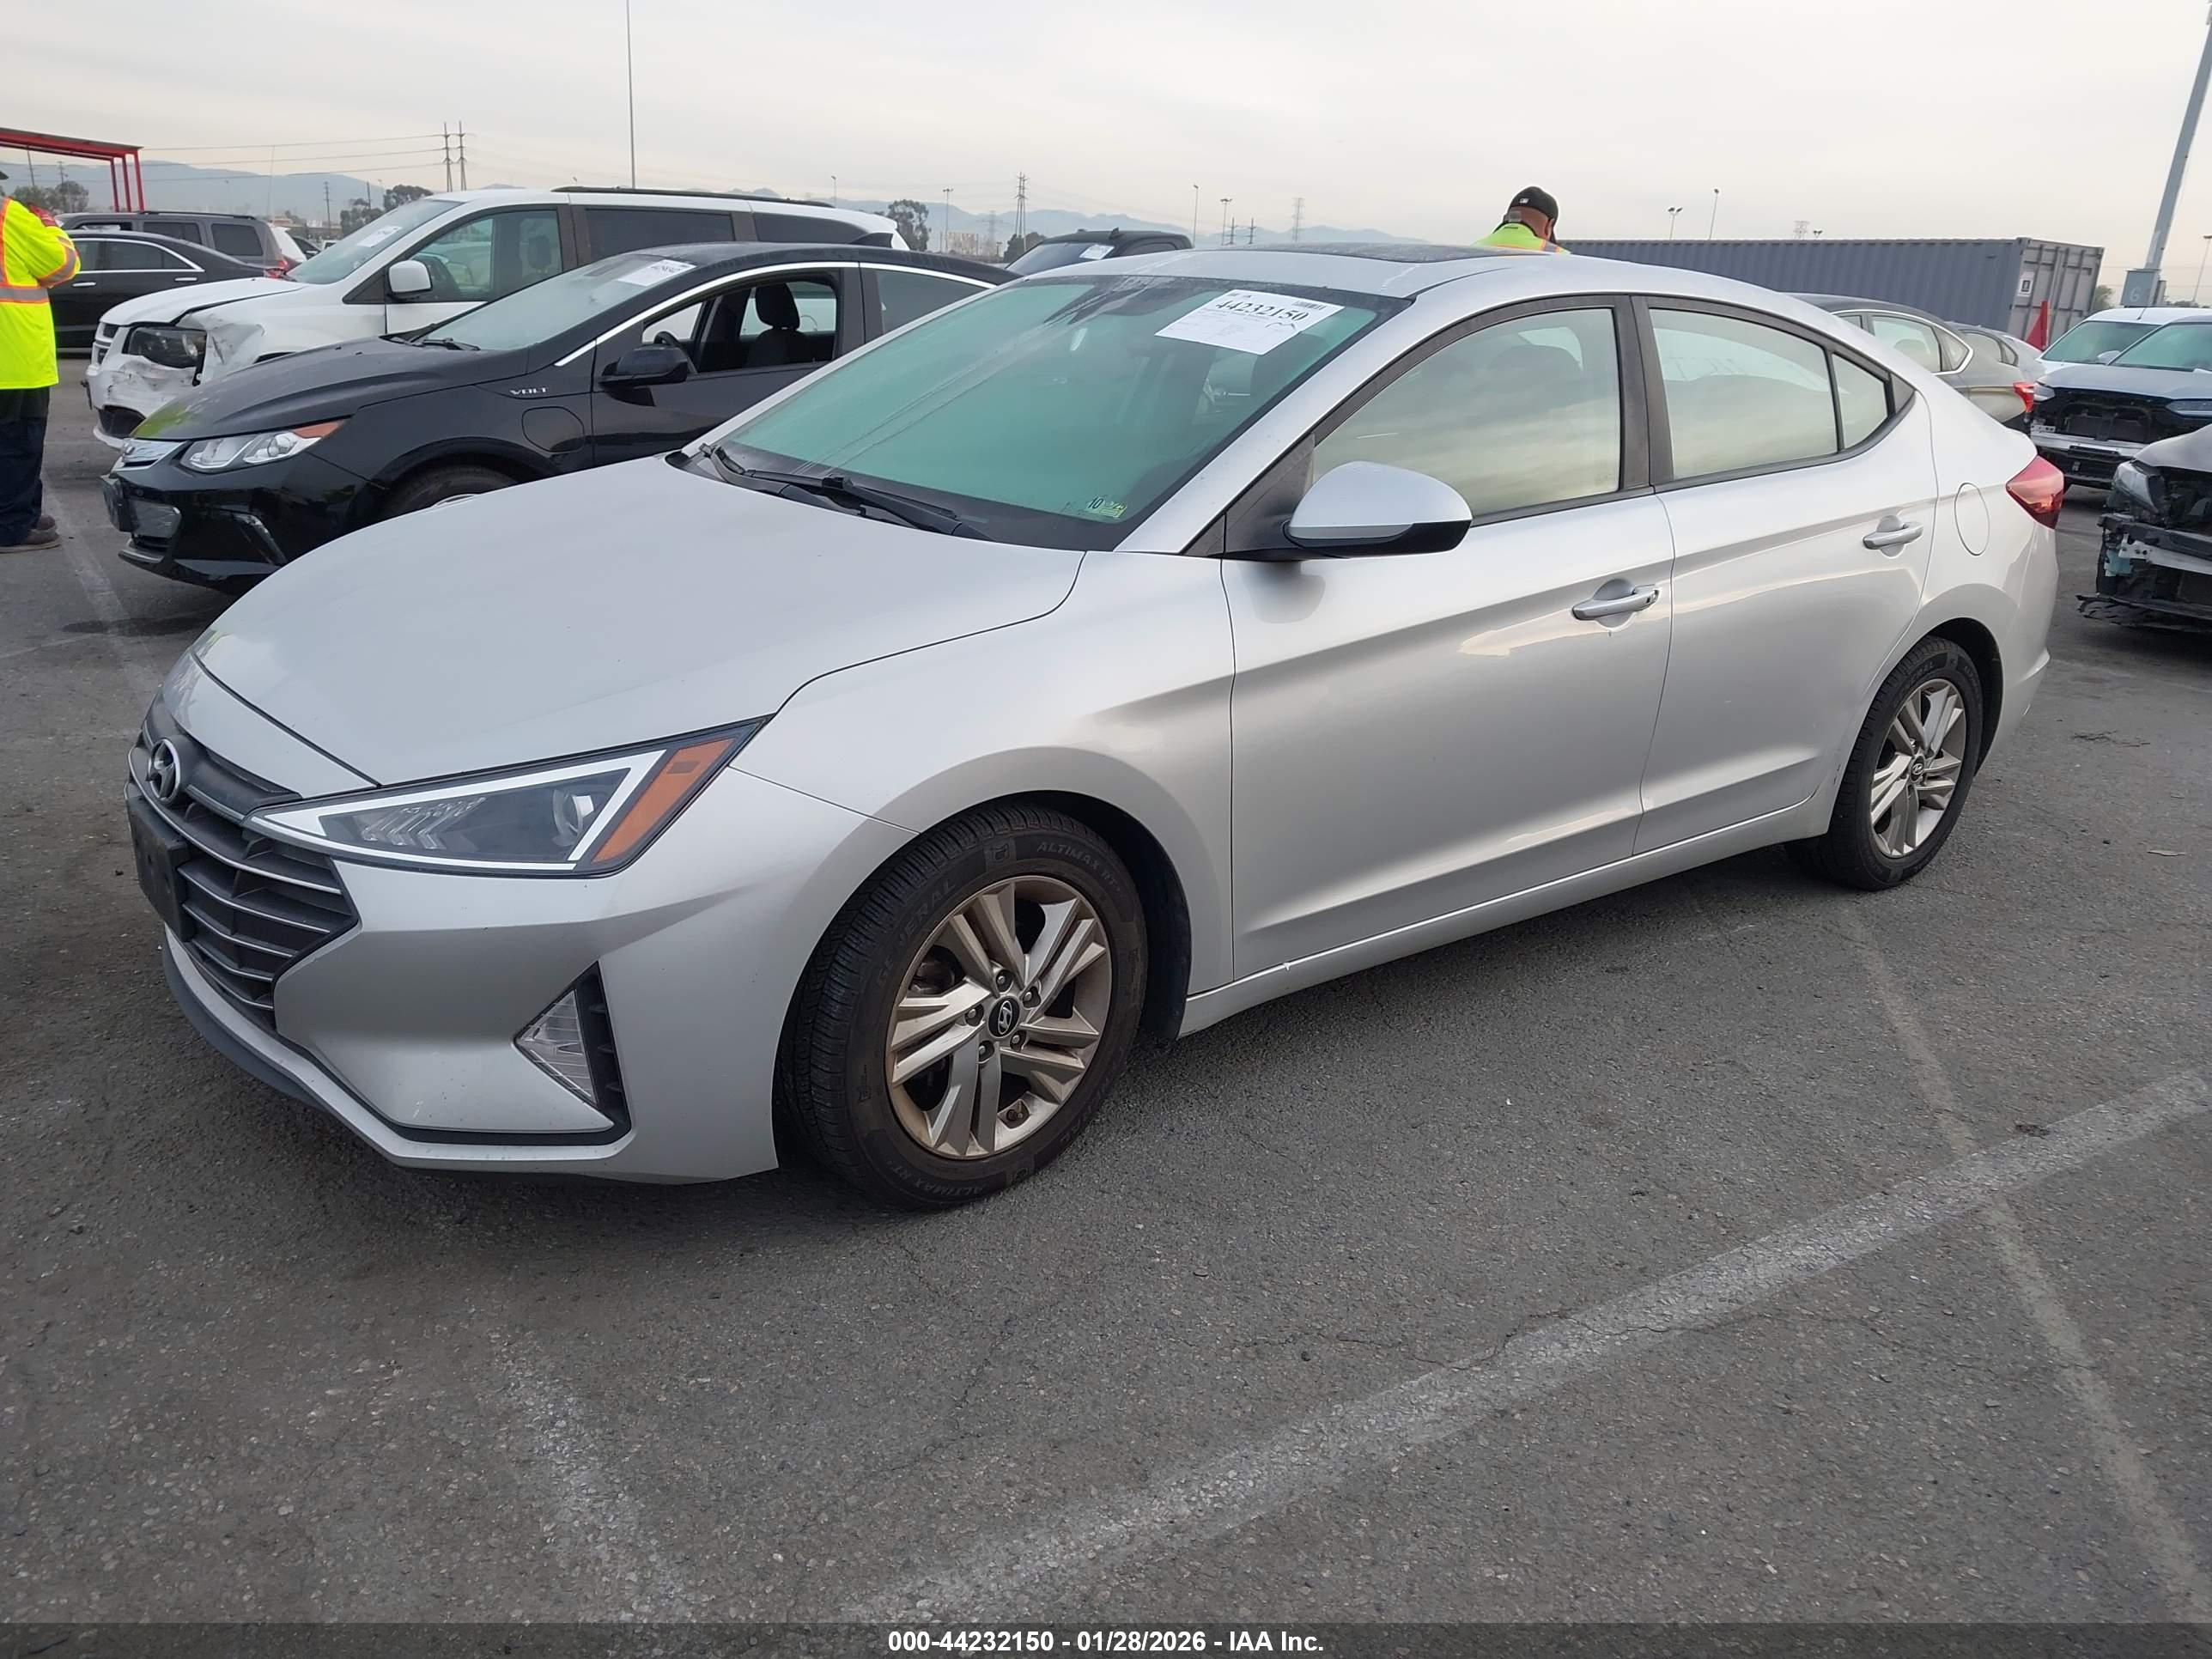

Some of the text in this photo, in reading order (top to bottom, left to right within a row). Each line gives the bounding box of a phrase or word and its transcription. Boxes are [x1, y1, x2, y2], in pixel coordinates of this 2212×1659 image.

[1215, 300, 1310, 322] 44232150
[1087, 496, 1104, 509] 10
[1036, 842, 1100, 871] ALTIMAX
